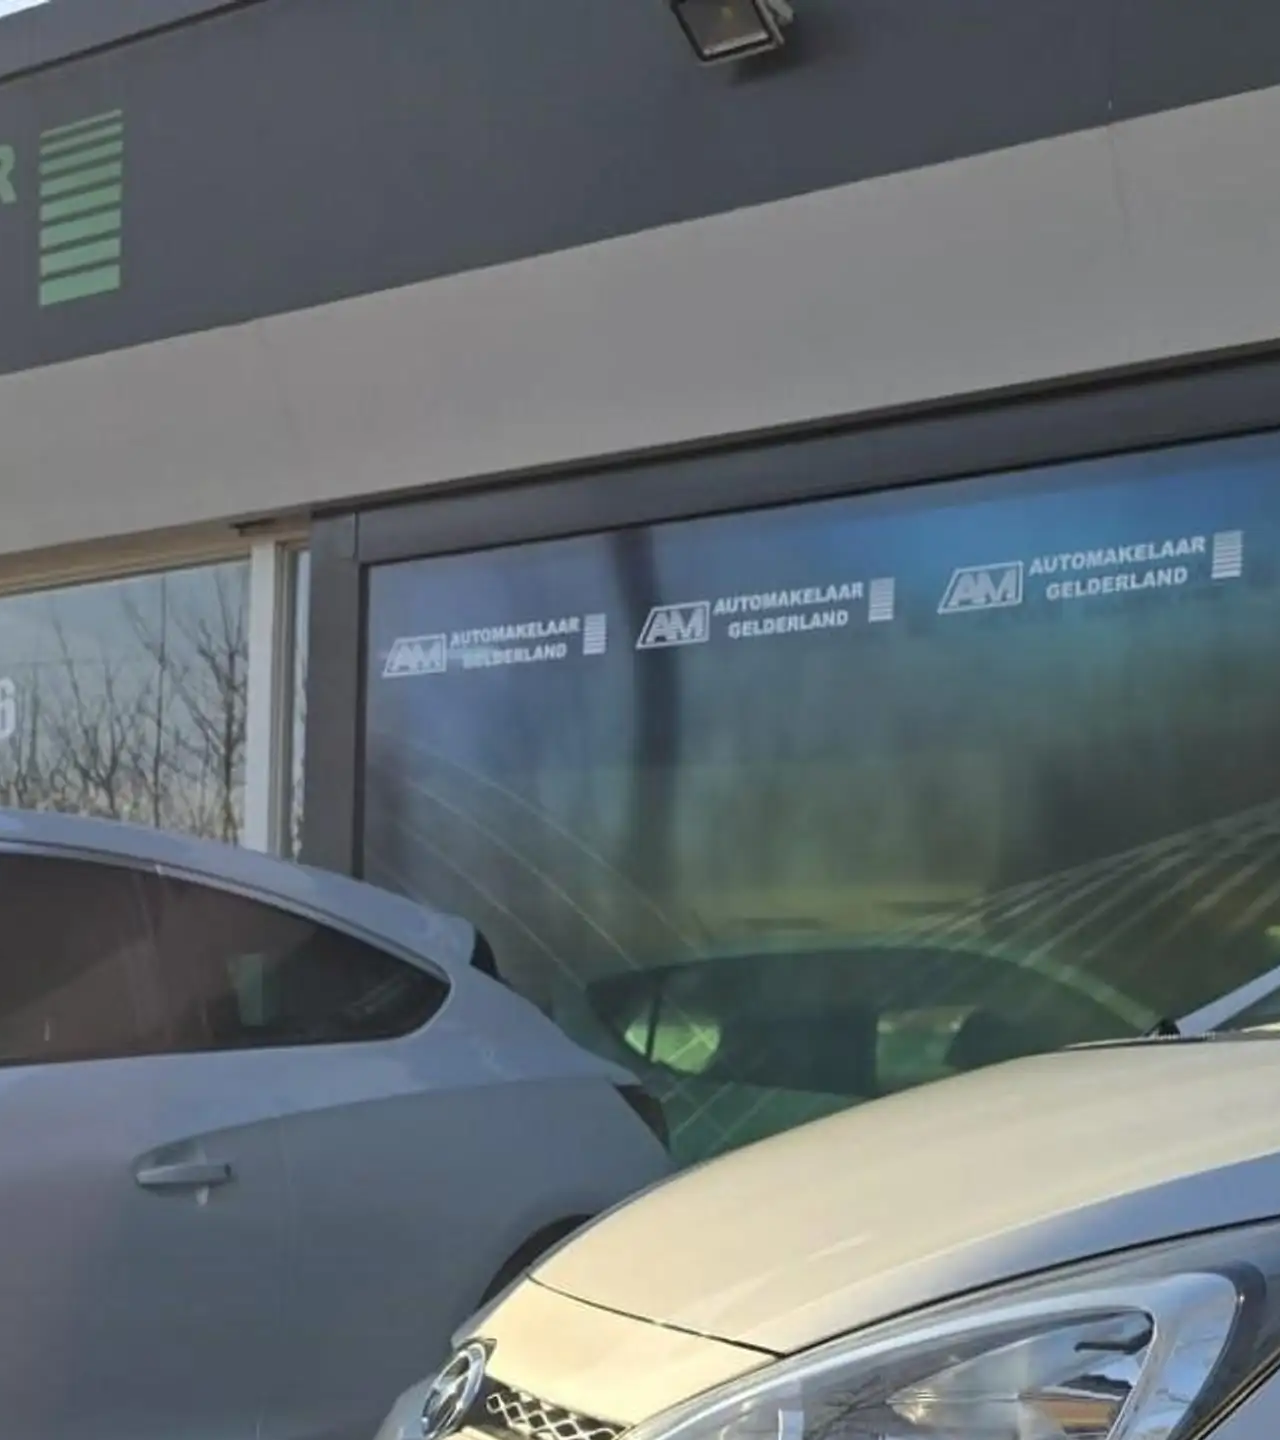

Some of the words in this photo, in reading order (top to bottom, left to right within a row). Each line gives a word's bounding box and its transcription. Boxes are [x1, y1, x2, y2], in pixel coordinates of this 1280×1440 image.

[1029, 536, 1206, 576] AUTOMAKELAAR
[712, 581, 864, 616] AUTOMAKELAAR
[1046, 567, 1187, 600] GELDERLAND
[450, 617, 580, 648] AUTOMAKELAAR
[728, 609, 849, 639] GELDERLAND
[462, 643, 568, 669] GELDERLAND
